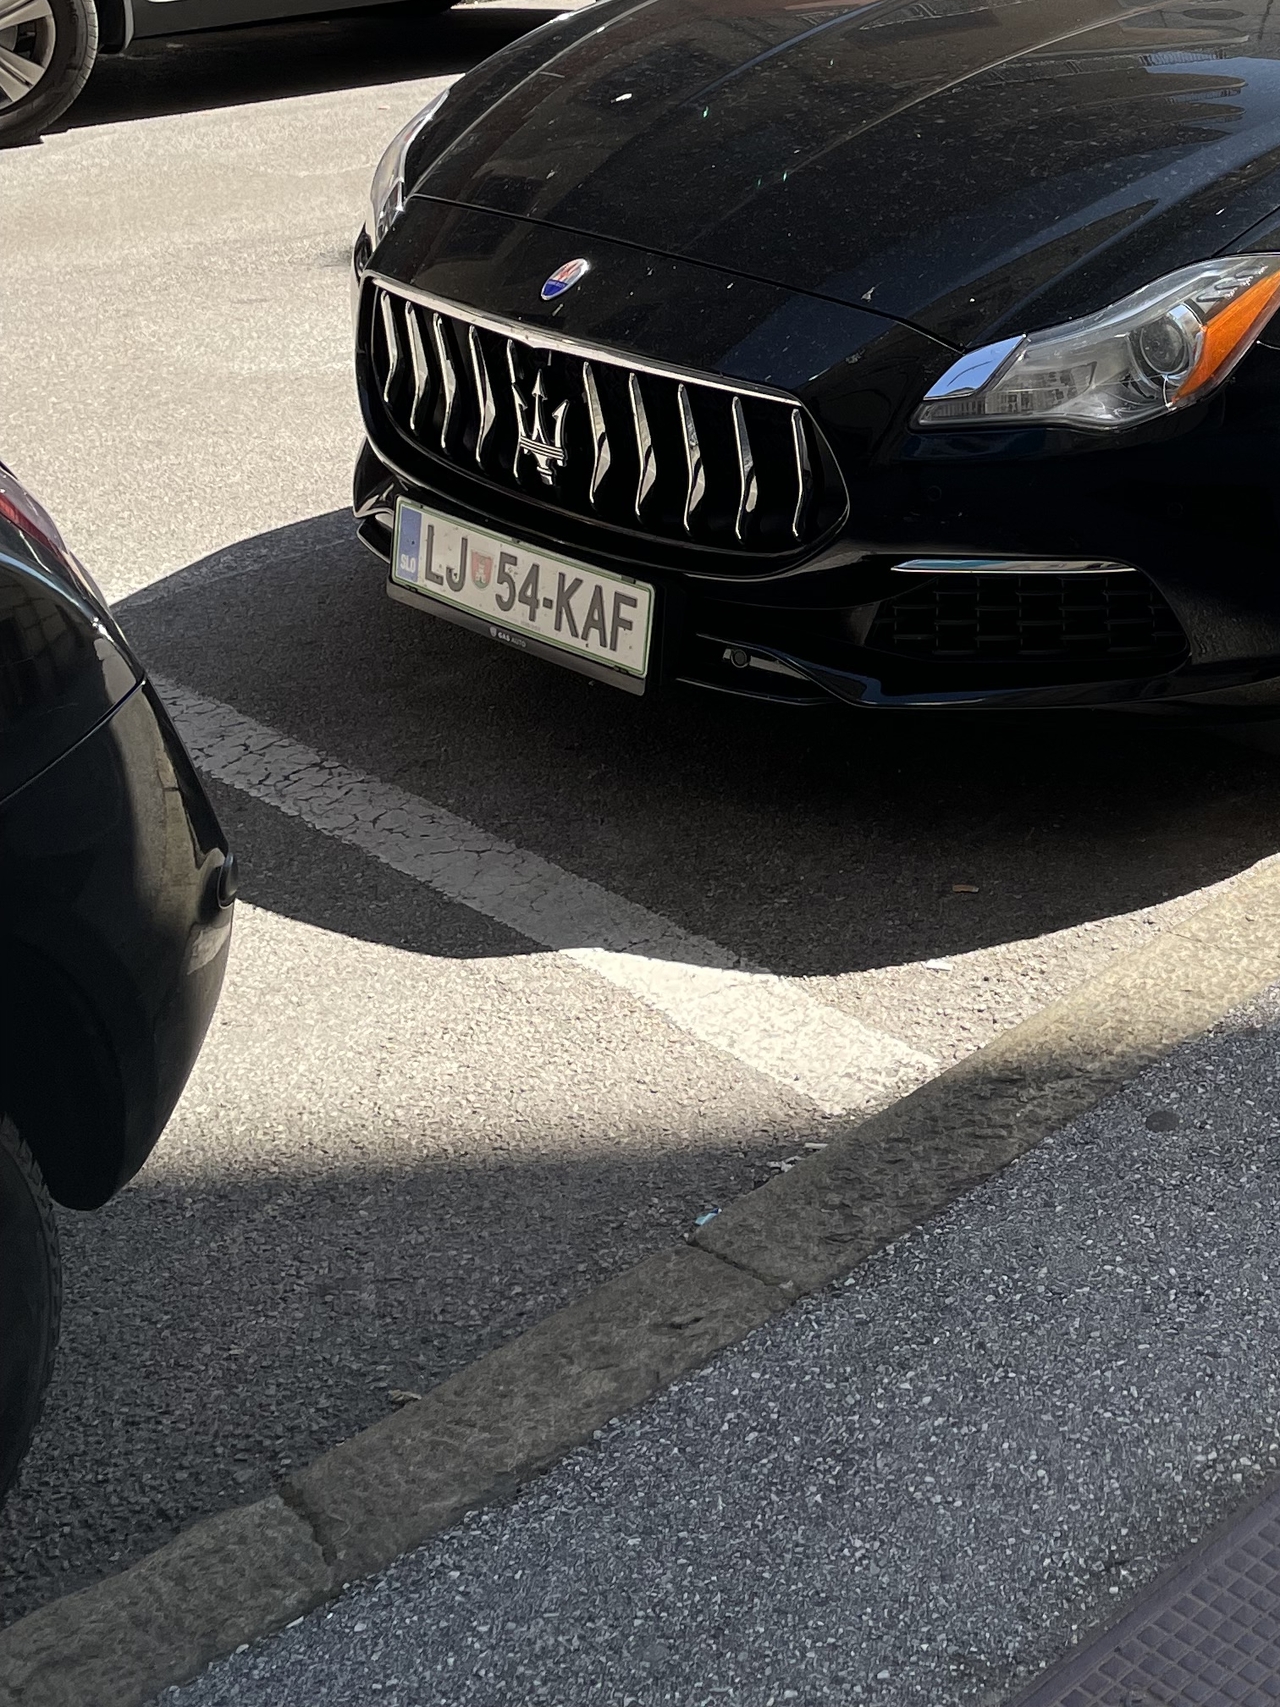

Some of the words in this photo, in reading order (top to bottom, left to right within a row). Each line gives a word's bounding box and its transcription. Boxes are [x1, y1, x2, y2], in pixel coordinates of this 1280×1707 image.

[400, 553, 416, 574] SLO
[424, 524, 468, 592] LJ
[495, 551, 638, 652] 54-KAF
